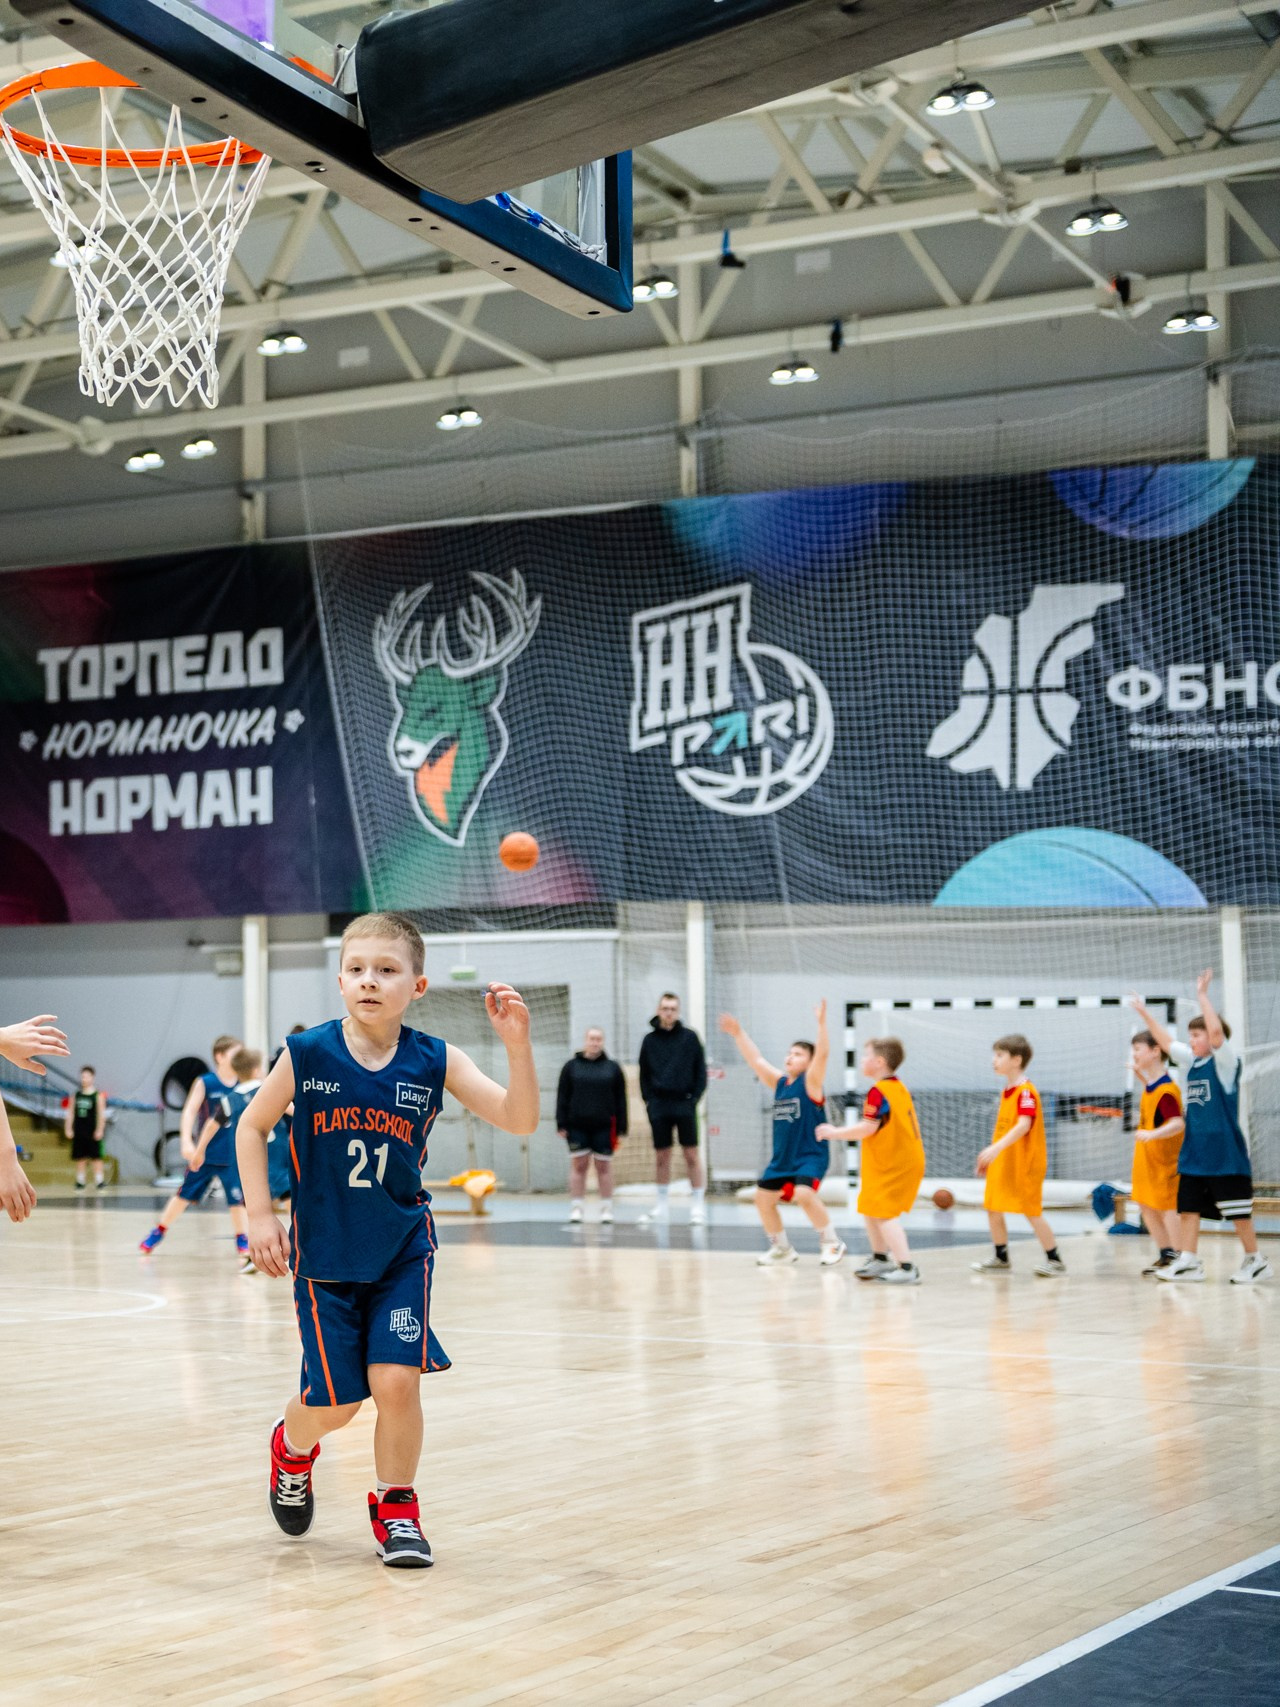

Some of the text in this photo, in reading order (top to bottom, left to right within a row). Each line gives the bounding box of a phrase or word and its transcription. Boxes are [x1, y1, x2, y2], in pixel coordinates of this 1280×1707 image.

[37, 627, 284, 703] ТОРПЕДО
[43, 706, 276, 760] НОРМАНОЧКА
[49, 766, 273, 836] НОРМАН
[313, 1106, 415, 1147] PLAYS.SCHOOL
[347, 1139, 389, 1188] 21
